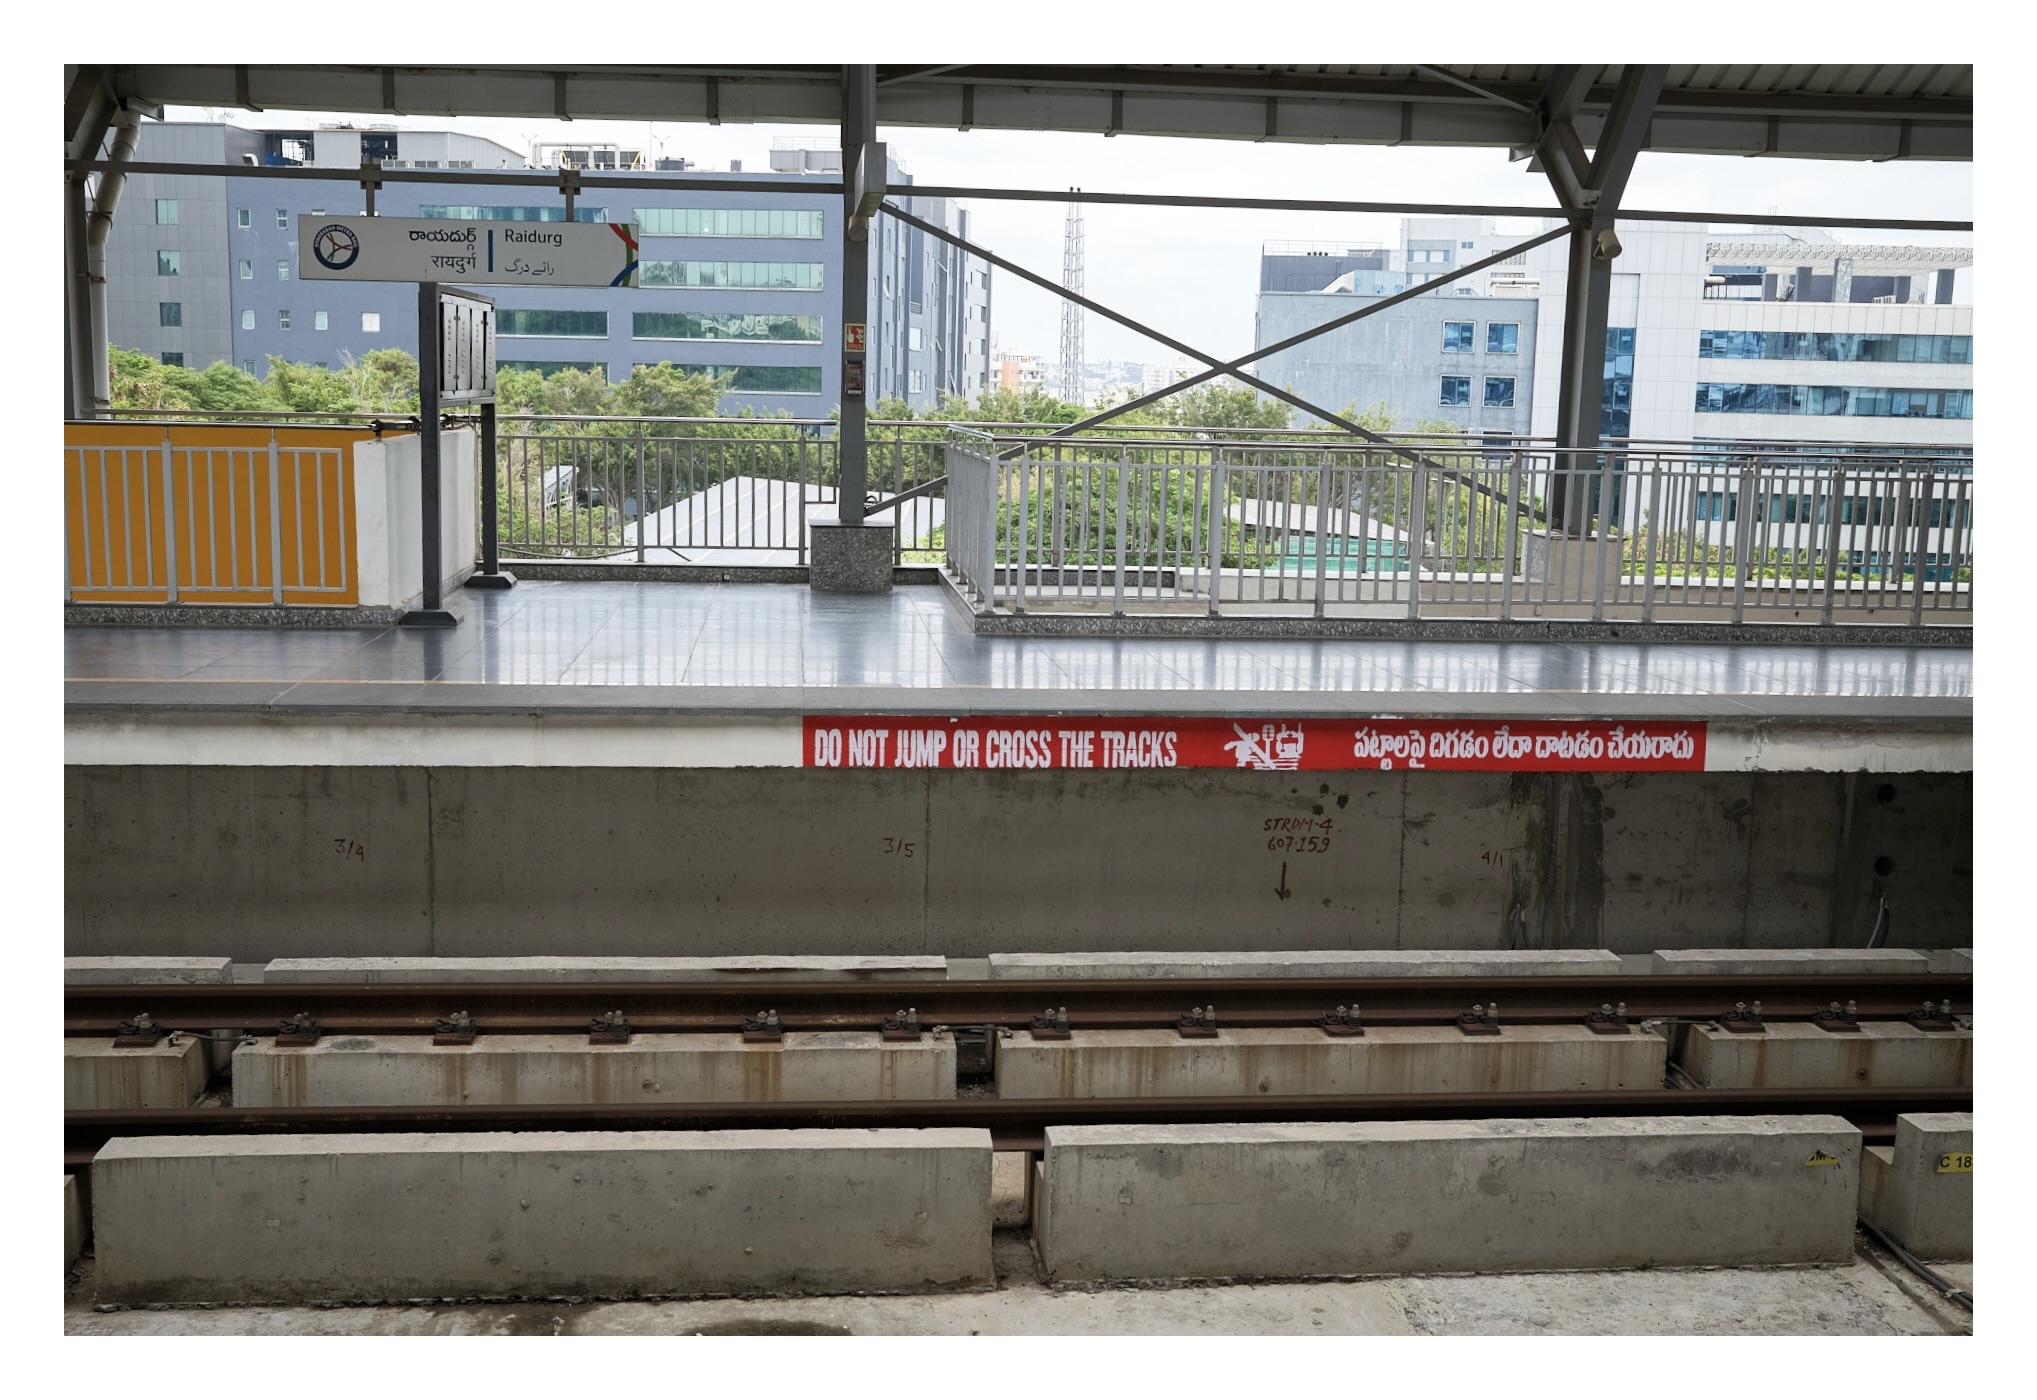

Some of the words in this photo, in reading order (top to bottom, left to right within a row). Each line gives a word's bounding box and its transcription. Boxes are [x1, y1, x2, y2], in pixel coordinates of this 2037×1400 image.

[505, 229, 563, 247] Raidurg
[431, 252, 477, 274] रायदुर्ग
[815, 729, 842, 768] DO
[849, 729, 889, 768] NOT
[895, 730, 947, 768] JUMP
[953, 730, 980, 768] OR
[986, 730, 1052, 768] CROSS
[1059, 731, 1095, 768] THE
[1101, 731, 1177, 768] TRACKS
[1354, 726, 1426, 770] పట్టాలపై
[1429, 728, 1489, 758] దిగడం
[1492, 725, 1533, 758] లేదా
[1535, 730, 1604, 759] దాటడం
[1607, 725, 1695, 759] చేయరాదు
[333, 838, 365, 862] 3/4
[883, 837, 916, 858] 3/5
[1481, 850, 1504, 870] 4/1
[1940, 1156, 1950, 1168] C
[1956, 1156, 1973, 1168] 18
